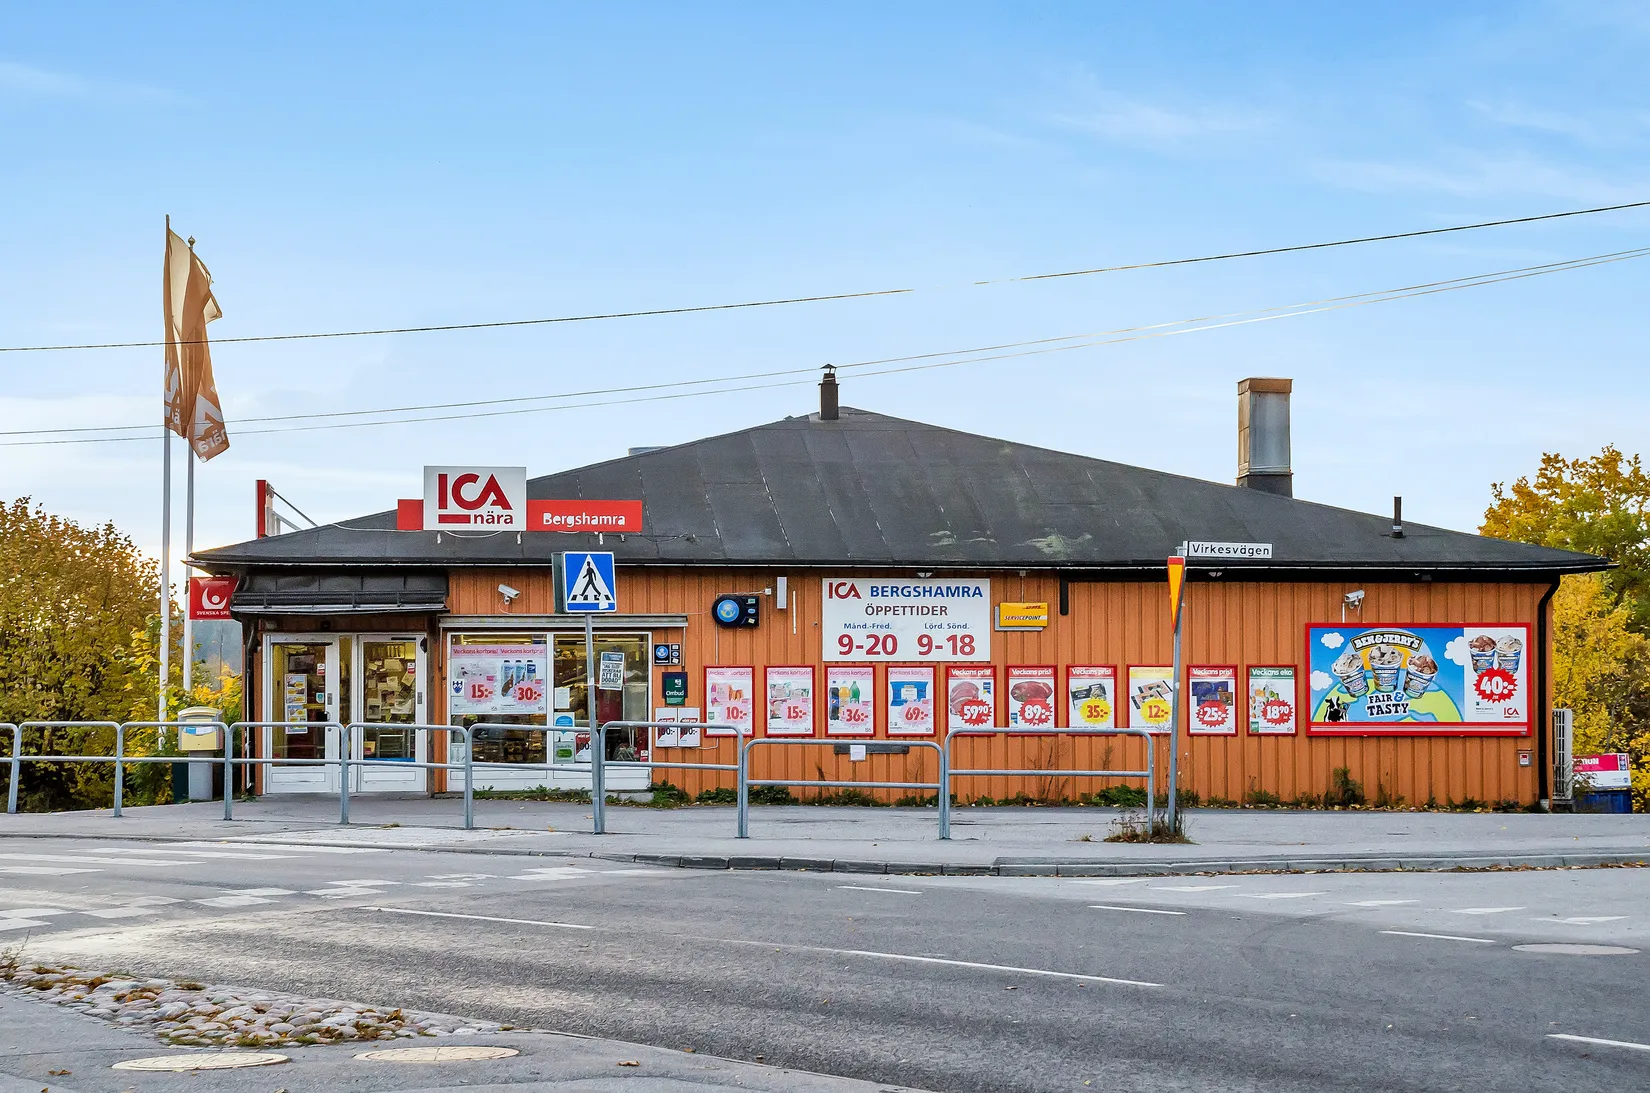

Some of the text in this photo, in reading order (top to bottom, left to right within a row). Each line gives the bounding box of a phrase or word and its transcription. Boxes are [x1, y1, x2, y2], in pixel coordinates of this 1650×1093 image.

[438, 473, 513, 510] ICA
[474, 511, 514, 525] nära
[542, 512, 626, 527] Bergshamra
[1192, 544, 1270, 556] Virkesvägen
[828, 582, 983, 600] ICA BERGSHAMRA
[864, 603, 948, 616] ÖPPETTIDER
[844, 622, 892, 630] Månd.-Fred.
[838, 634, 975, 656] 9-20 9-18
[471, 684, 494, 698] 15:-
[1480, 676, 1514, 694] 40:-
[518, 687, 542, 700] 30:-
[1368, 692, 1404, 704] FAIR &
[726, 706, 748, 719] 10:-
[787, 706, 806, 719] 15:-
[846, 709, 868, 722] 36:-
[905, 706, 928, 720] 69:-
[1024, 704, 1050, 719] 89:-
[1087, 705, 1108, 718] 35:-
[1148, 705, 1168, 718] 12:-
[1204, 707, 1227, 721] 25:-
[1367, 703, 1409, 716] TASTY
[1504, 707, 1519, 716] ICA
